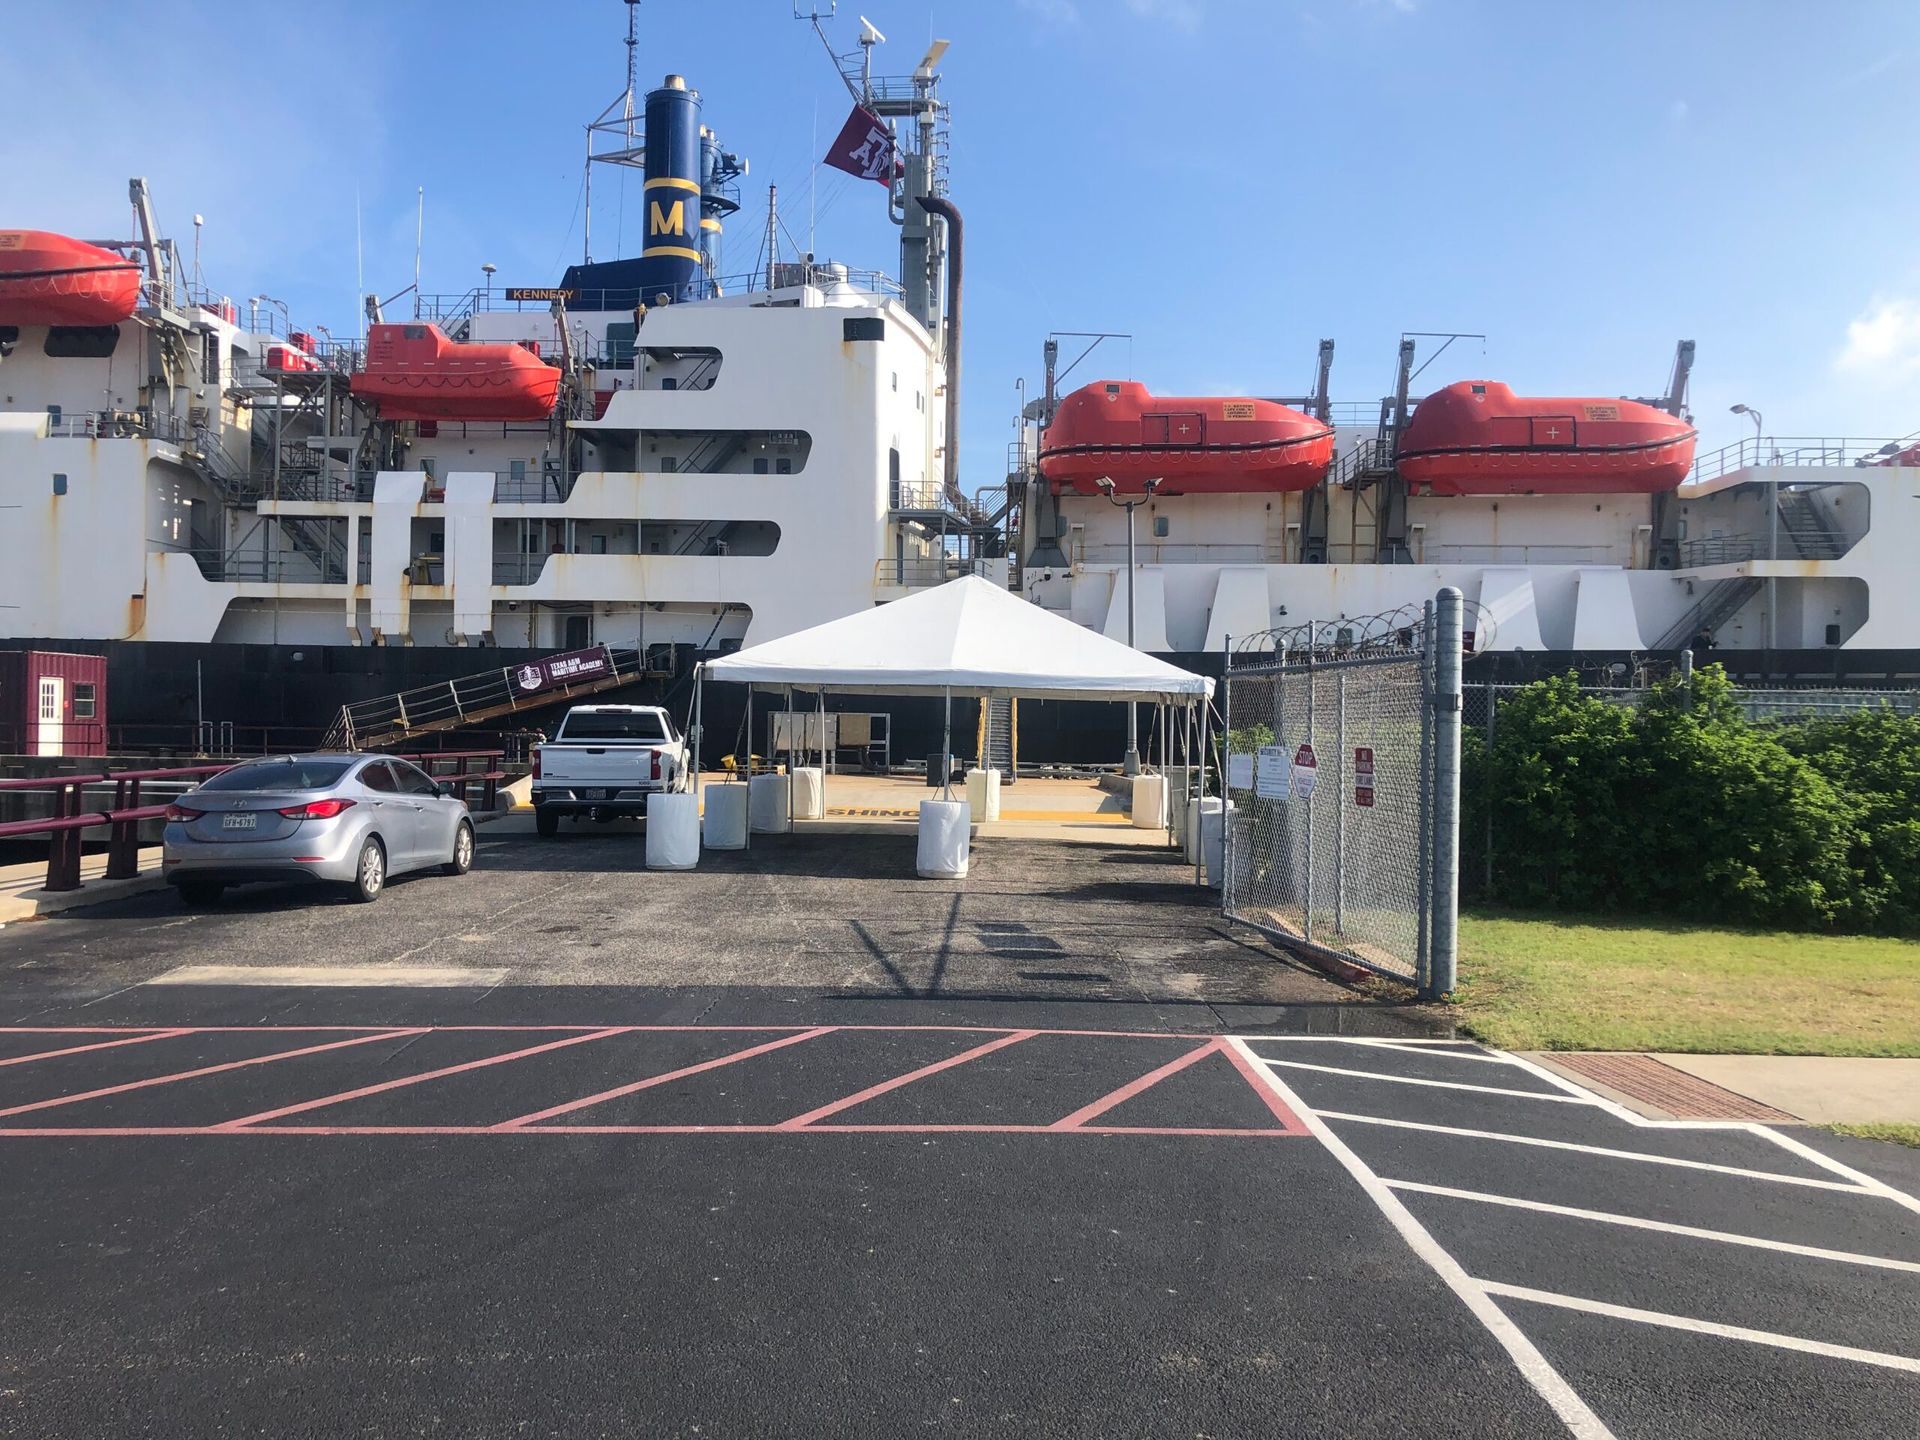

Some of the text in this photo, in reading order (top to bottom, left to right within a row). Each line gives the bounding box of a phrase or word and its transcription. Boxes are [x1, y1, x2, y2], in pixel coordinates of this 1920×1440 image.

[651, 200, 683, 236] M
[513, 289, 574, 300] KENNEDY
[550, 657, 580, 671] TEXAS A&M
[551, 665, 579, 677] MARITIME
[579, 660, 603, 671] ACADEMY
[1298, 751, 1313, 765] STOP
[826, 808, 920, 817] SHING
